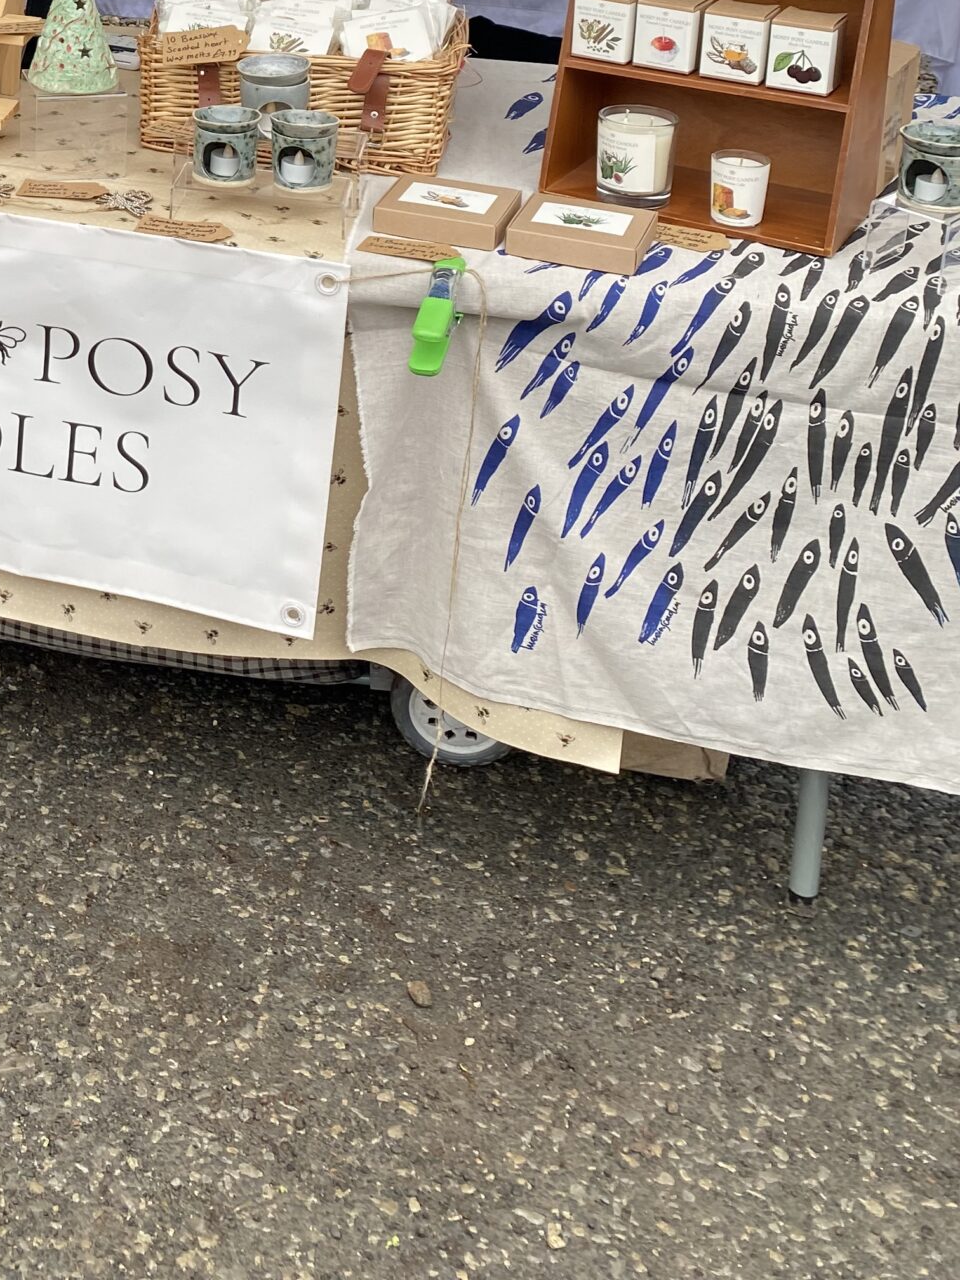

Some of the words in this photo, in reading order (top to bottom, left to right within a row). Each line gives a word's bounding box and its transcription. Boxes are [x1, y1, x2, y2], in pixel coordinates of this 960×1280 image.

[166, 36, 176, 44] 10
[181, 31, 218, 43] Beeswax
[166, 42, 200, 53] Scented
[33, 324, 270, 418] POSY
